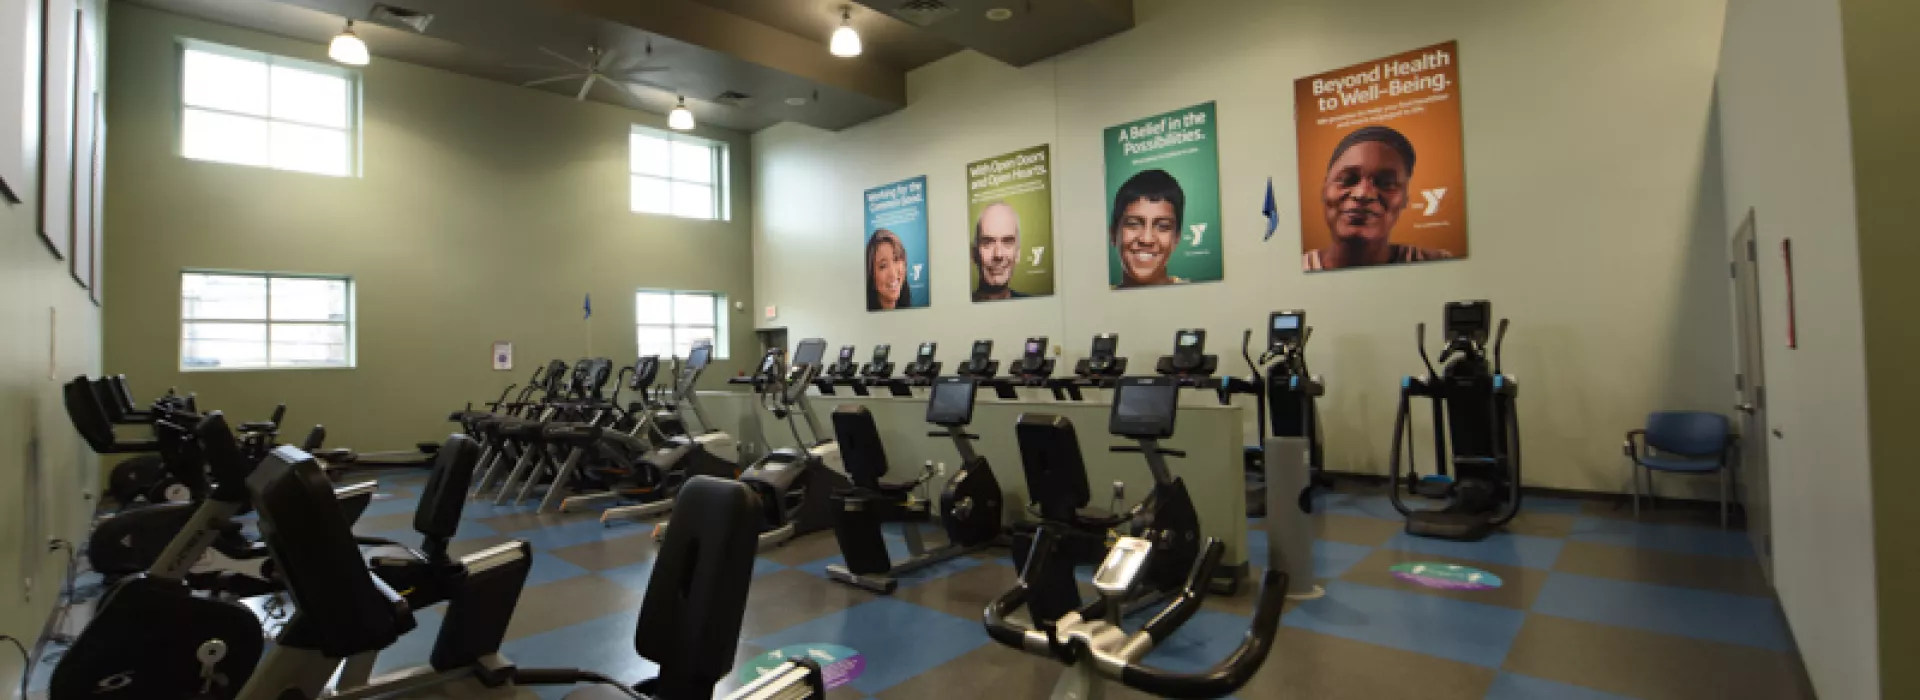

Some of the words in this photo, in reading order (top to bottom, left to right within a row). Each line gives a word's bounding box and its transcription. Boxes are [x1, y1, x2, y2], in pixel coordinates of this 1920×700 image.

[1312, 65, 1381, 95] Beyond
[1384, 50, 1450, 79] Health
[1319, 97, 1338, 112] to
[1340, 73, 1451, 106] Well-Being.
[1118, 129, 1128, 143] A
[1129, 118, 1165, 139] Belief
[1167, 117, 1181, 130] in
[1183, 112, 1206, 127] the
[1123, 129, 1206, 156] Possibilities.
